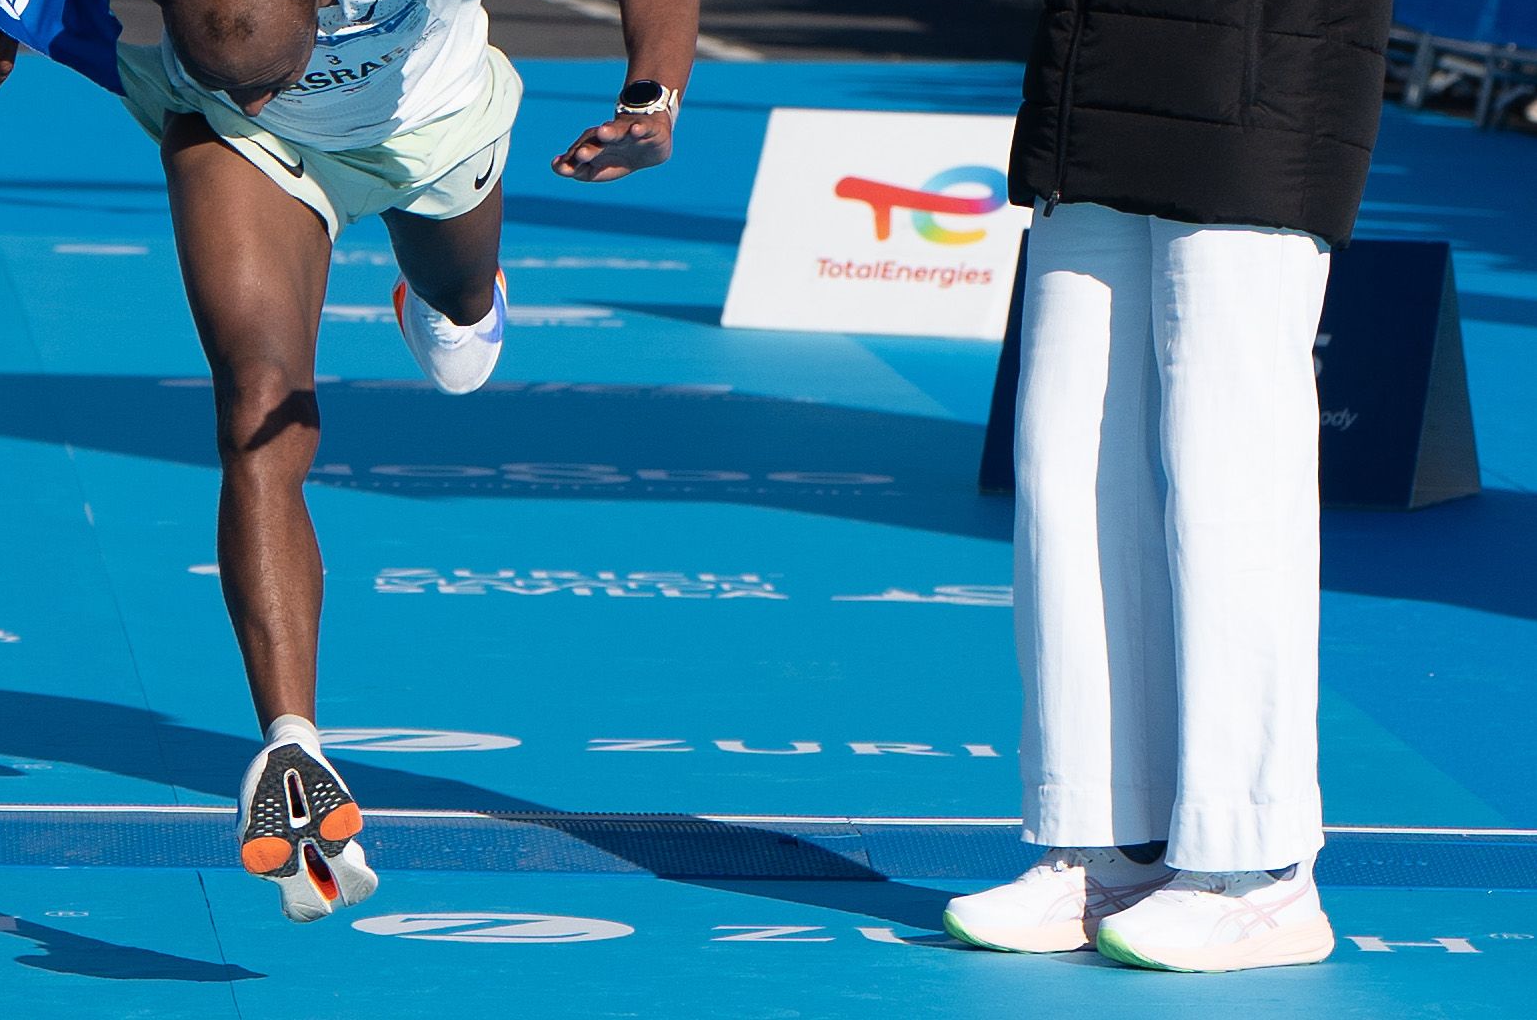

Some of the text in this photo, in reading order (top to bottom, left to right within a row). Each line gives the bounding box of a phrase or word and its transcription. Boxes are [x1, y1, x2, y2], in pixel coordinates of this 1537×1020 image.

[325, 54, 342, 66] 3
[816, 258, 994, 288] TotalEnergies
[1320, 407, 1358, 431] ody
[587, 738, 1002, 758] ZURI
